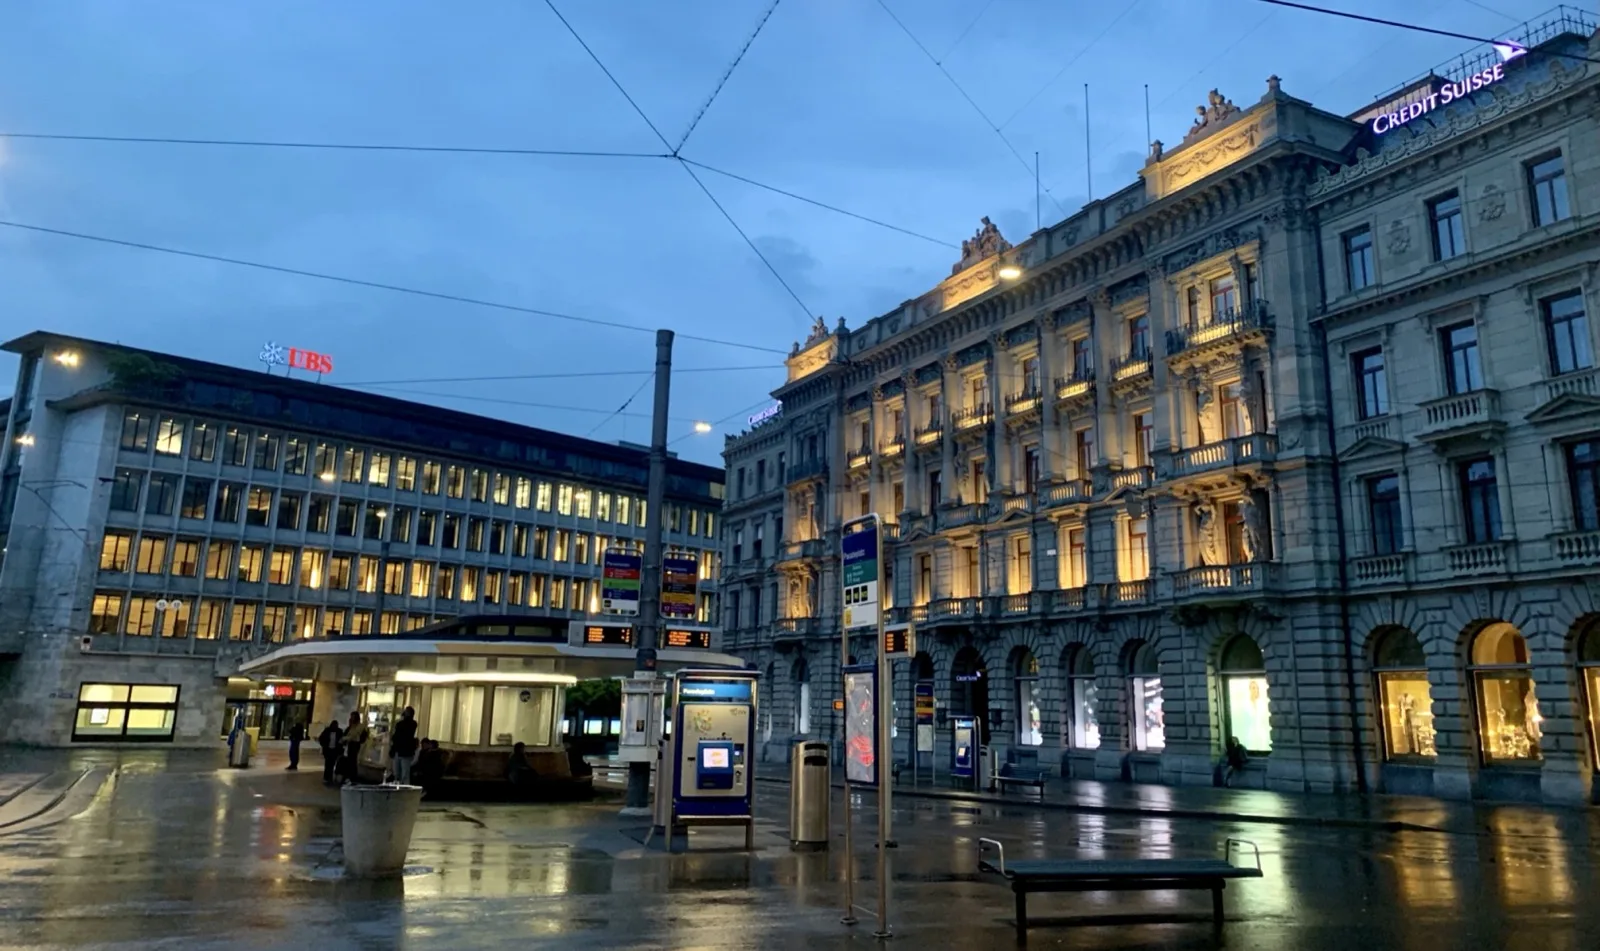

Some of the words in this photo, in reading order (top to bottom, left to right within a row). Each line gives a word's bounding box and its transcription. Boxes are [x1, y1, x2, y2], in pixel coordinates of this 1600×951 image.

[1372, 93, 1438, 135] CREDIT
[1441, 63, 1505, 105] SUISSE
[289, 346, 333, 374] UBS
